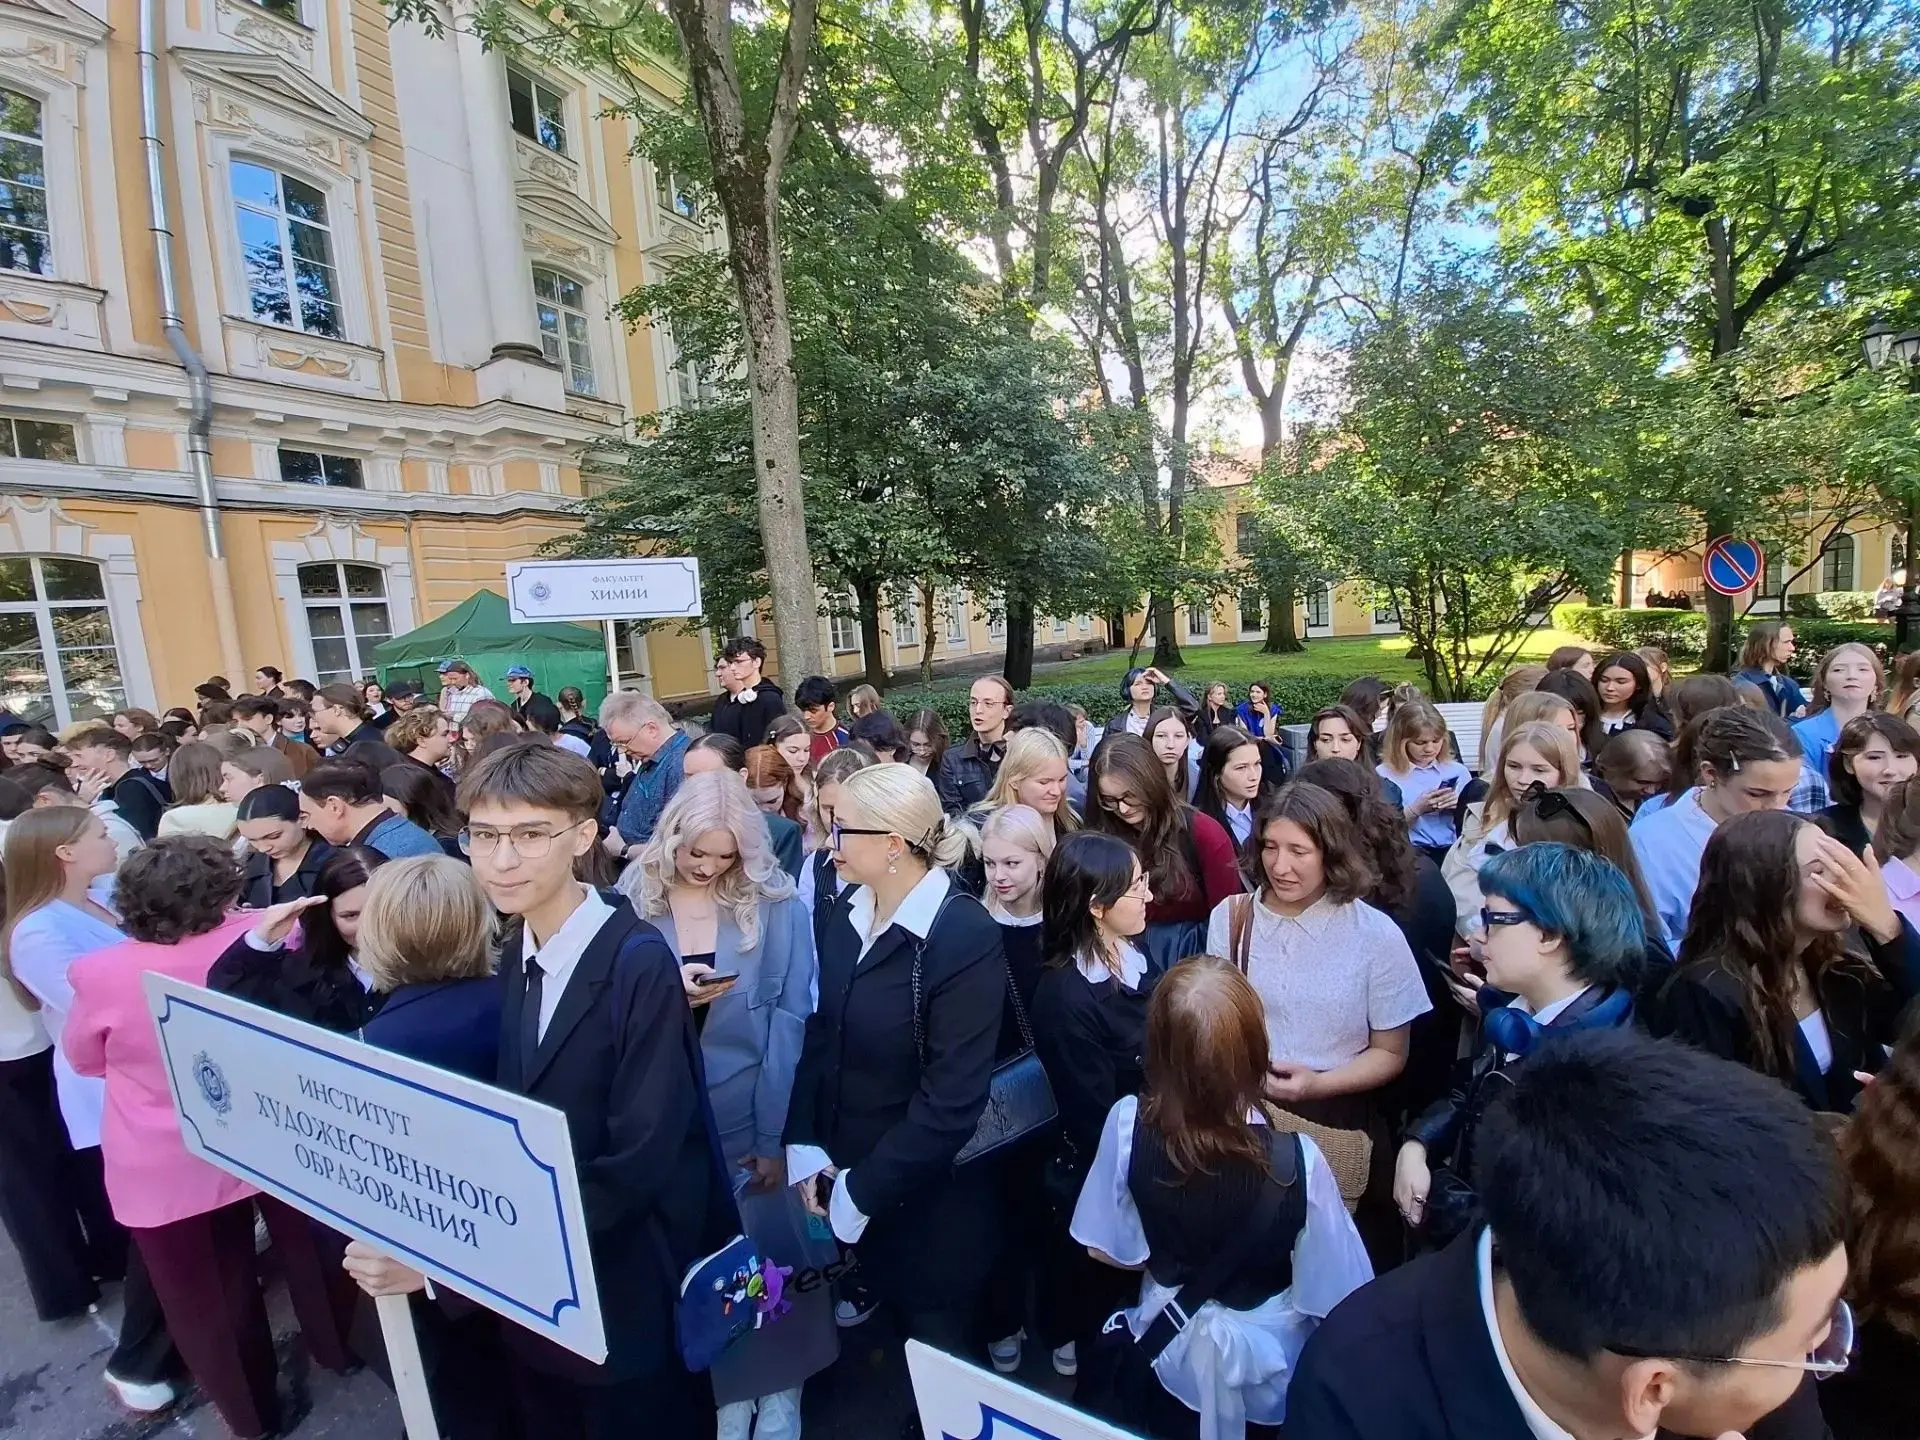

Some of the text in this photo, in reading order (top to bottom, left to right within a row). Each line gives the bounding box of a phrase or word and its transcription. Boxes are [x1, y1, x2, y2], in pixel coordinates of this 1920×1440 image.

[590, 588, 648, 601] ХИМИИ
[592, 575, 644, 584] ФАКУЛЬТЕТ
[297, 1074, 411, 1137] ИНСТИТУТ
[253, 1091, 518, 1227] ХУДОЖЕСТВЕННОГО
[295, 1143, 481, 1250] ОБРАЗОВАНИЯ
